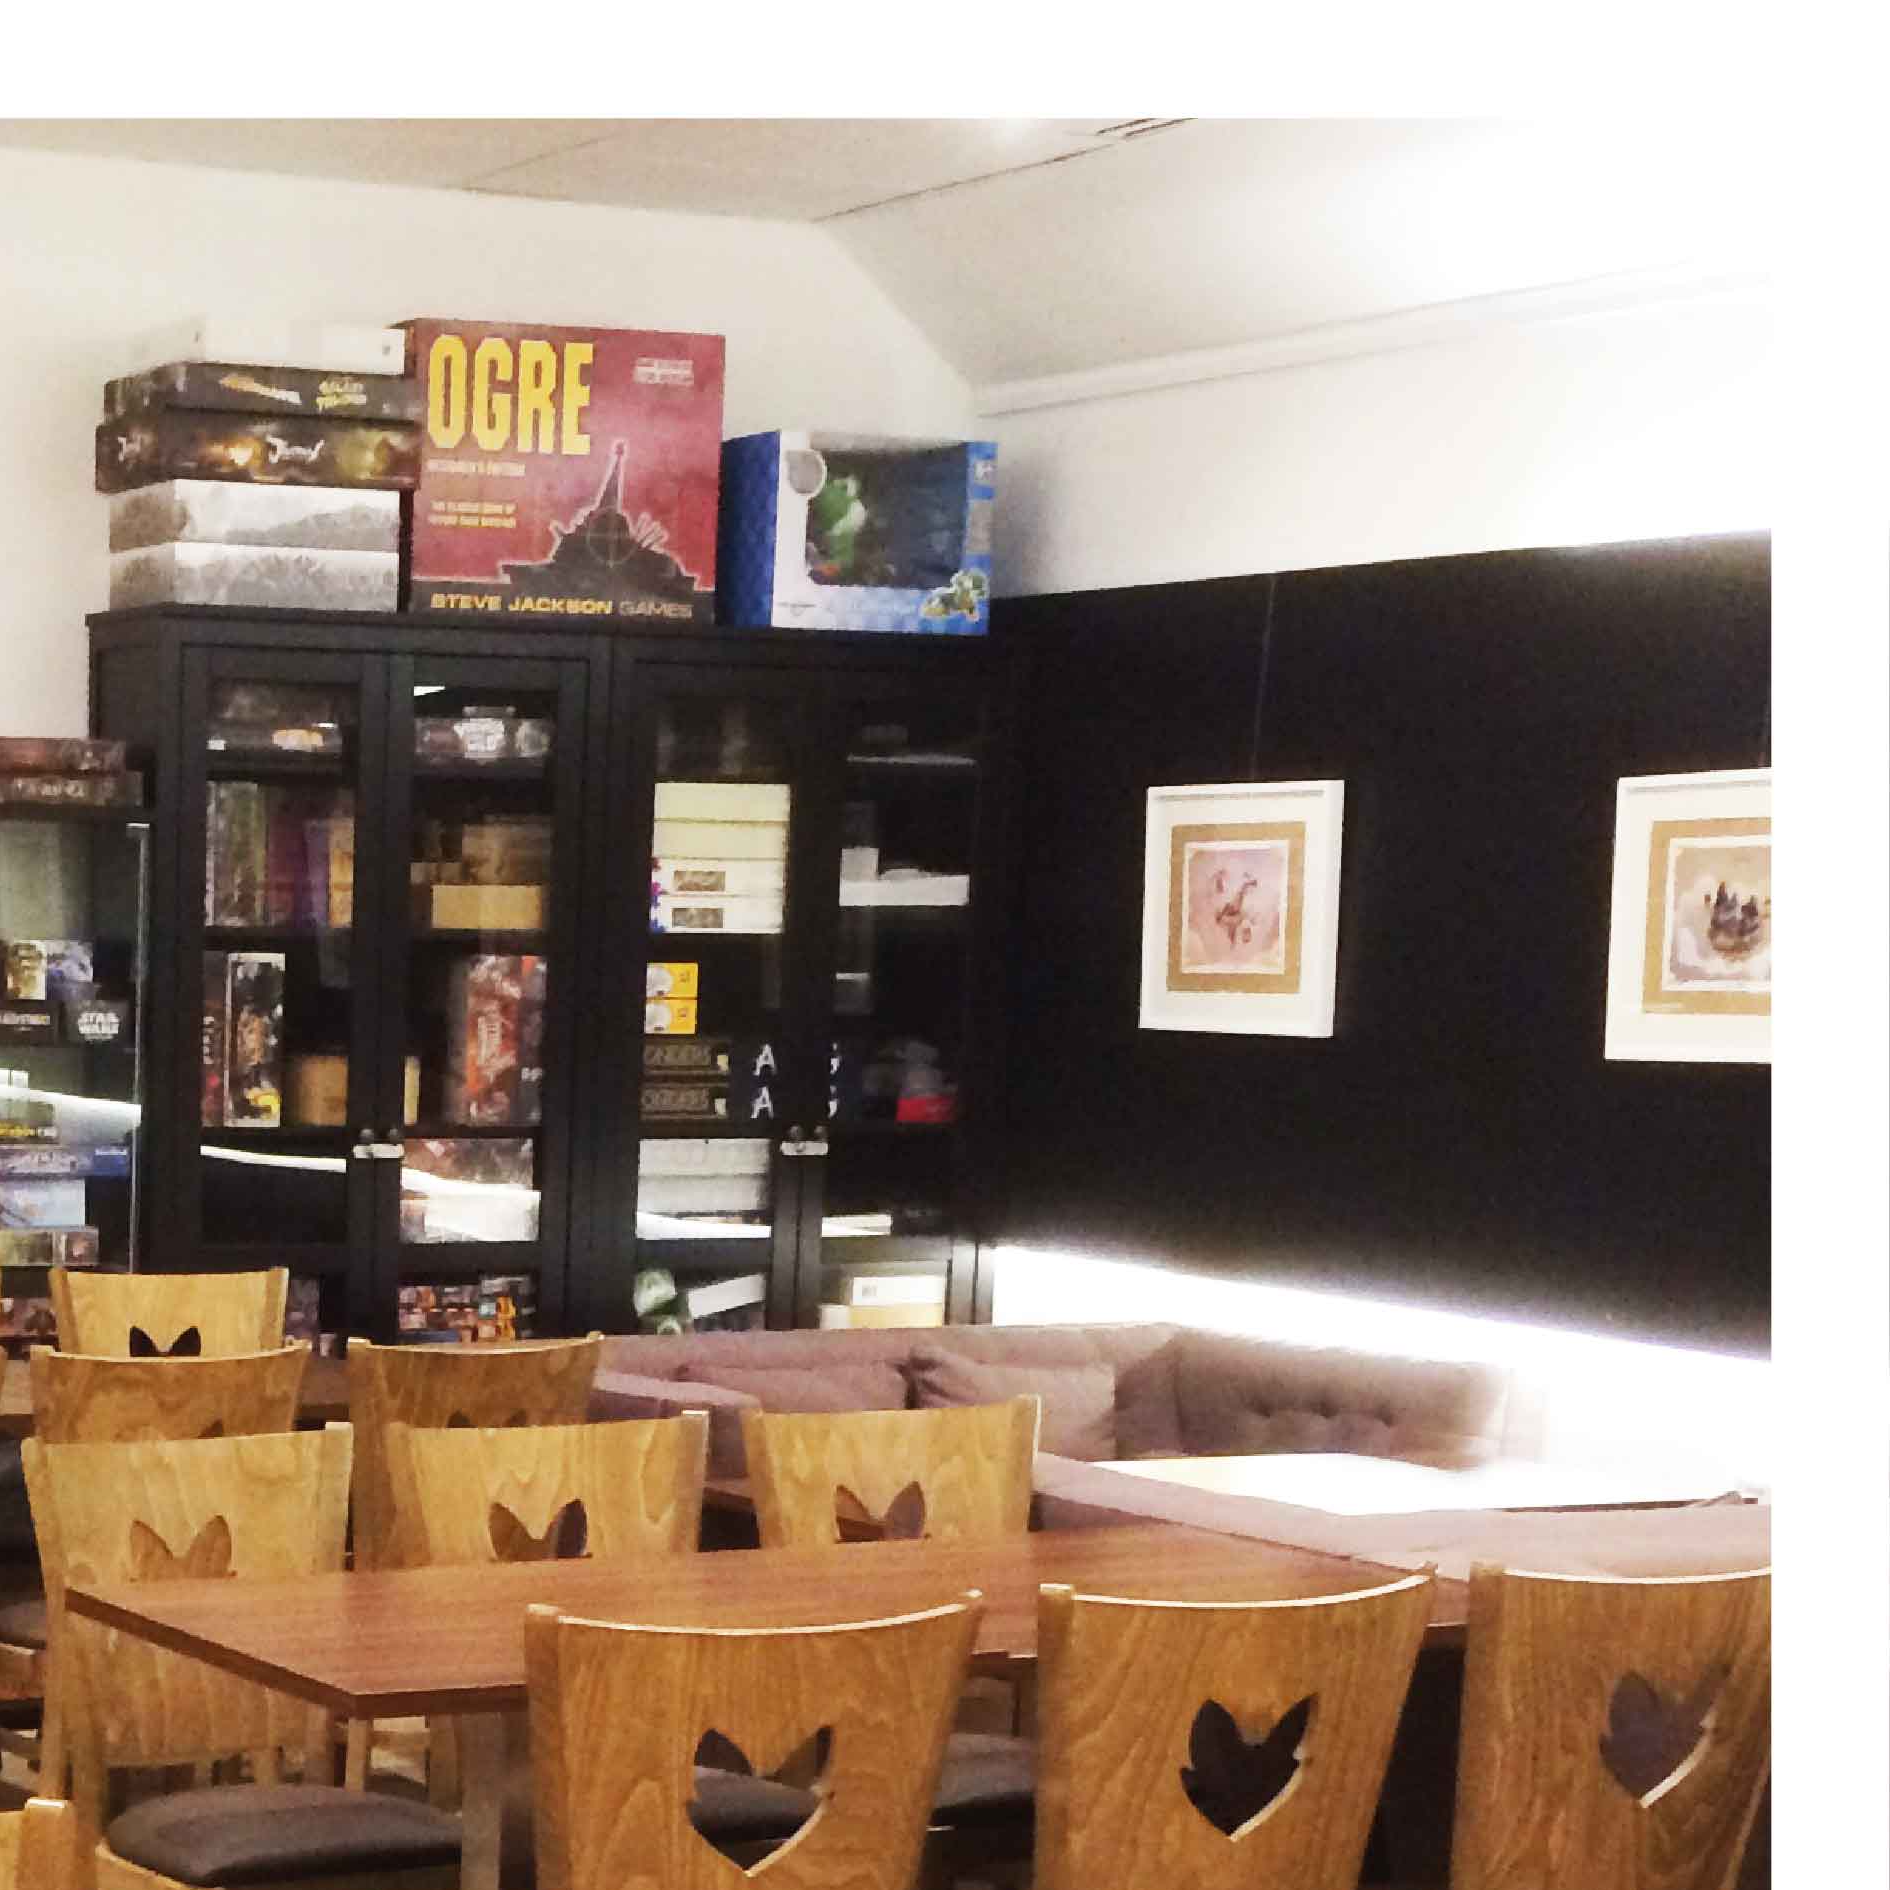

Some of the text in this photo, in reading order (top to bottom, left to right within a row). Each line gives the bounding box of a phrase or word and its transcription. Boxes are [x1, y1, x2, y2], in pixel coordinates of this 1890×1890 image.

[428, 334, 594, 455] OGRE
[430, 592, 694, 619] STEVE JACKSON GAMES
